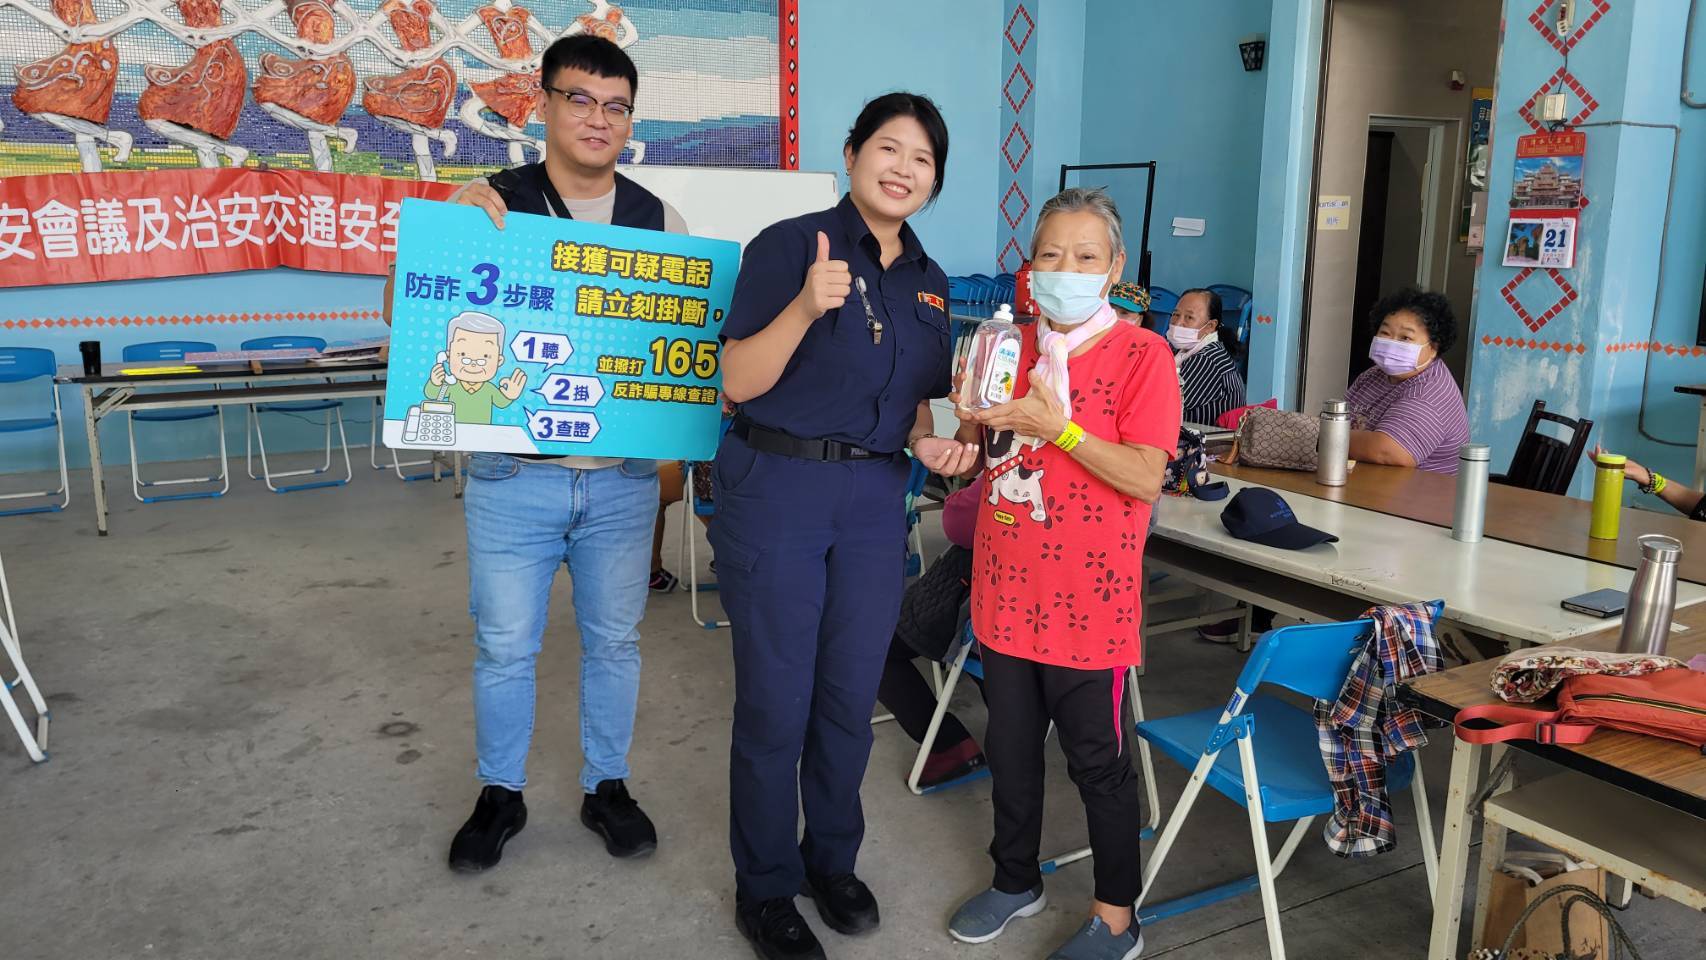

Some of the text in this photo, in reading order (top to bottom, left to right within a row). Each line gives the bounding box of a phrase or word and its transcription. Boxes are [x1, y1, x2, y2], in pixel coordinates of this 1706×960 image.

[1544, 228, 1567, 248] 21
[551, 241, 713, 287] 接獲可疑電話
[404, 262, 556, 312] 防詐3步驟
[522, 336, 560, 361] 1聽
[553, 378, 590, 403] 2掛
[612, 382, 718, 405] 反詐騙專線查證
[536, 416, 591, 440] 3查證
